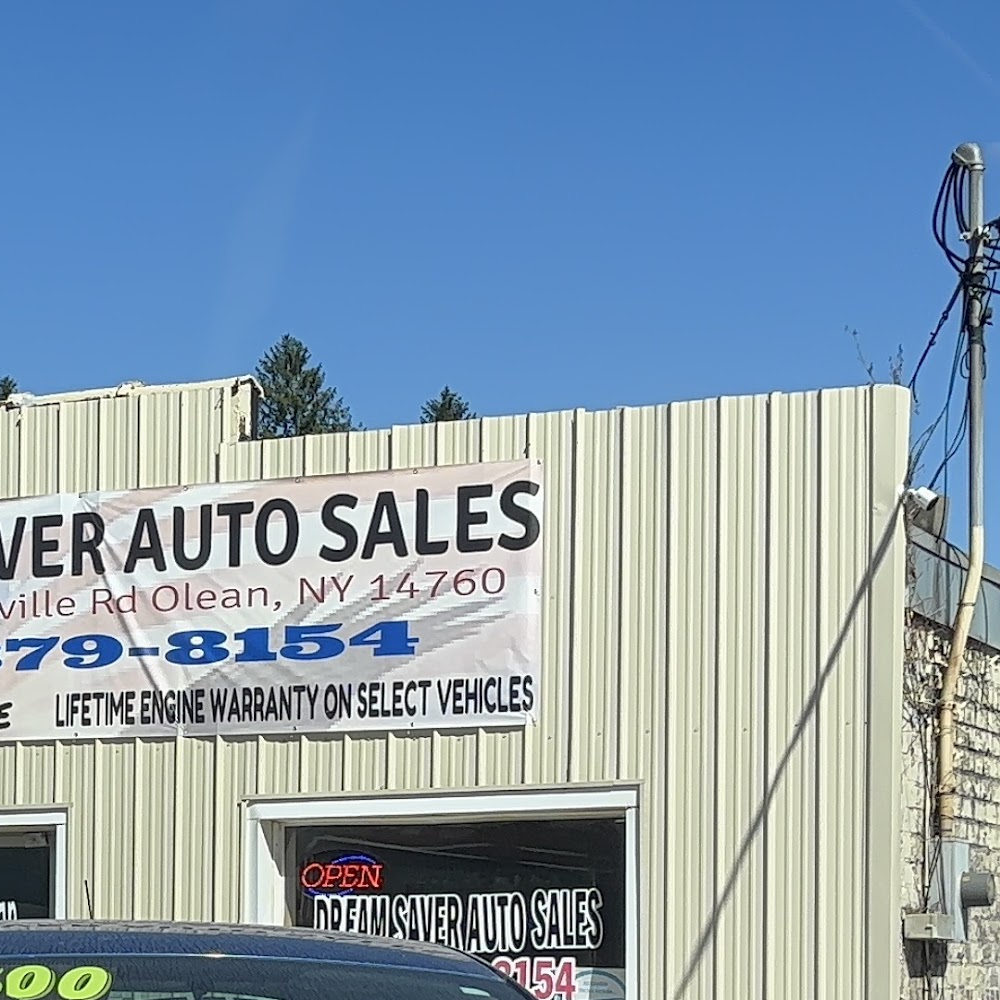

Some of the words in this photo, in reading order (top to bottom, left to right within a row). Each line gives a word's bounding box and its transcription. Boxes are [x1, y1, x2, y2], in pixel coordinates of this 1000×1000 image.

[124, 498, 300, 573] AUTO
[319, 481, 541, 562] SALES
[91, 588, 137, 615] Rd
[153, 582, 282, 614] Olean,
[300, 574, 355, 604] NY
[371, 567, 506, 601] 14760
[55, 691, 135, 727] LIFETIME
[140, 689, 205, 724] ENGINE
[211, 684, 319, 722] WARRANTY
[324, 683, 353, 719] ON
[357, 679, 432, 718] SELECT
[437, 675, 534, 714] VEHICLES
[302, 863, 384, 889] OPEN
[314, 895, 390, 939] DREAM
[392, 894, 466, 951] SAVER
[465, 891, 527, 953] AUTO
[531, 887, 603, 949] SALES
